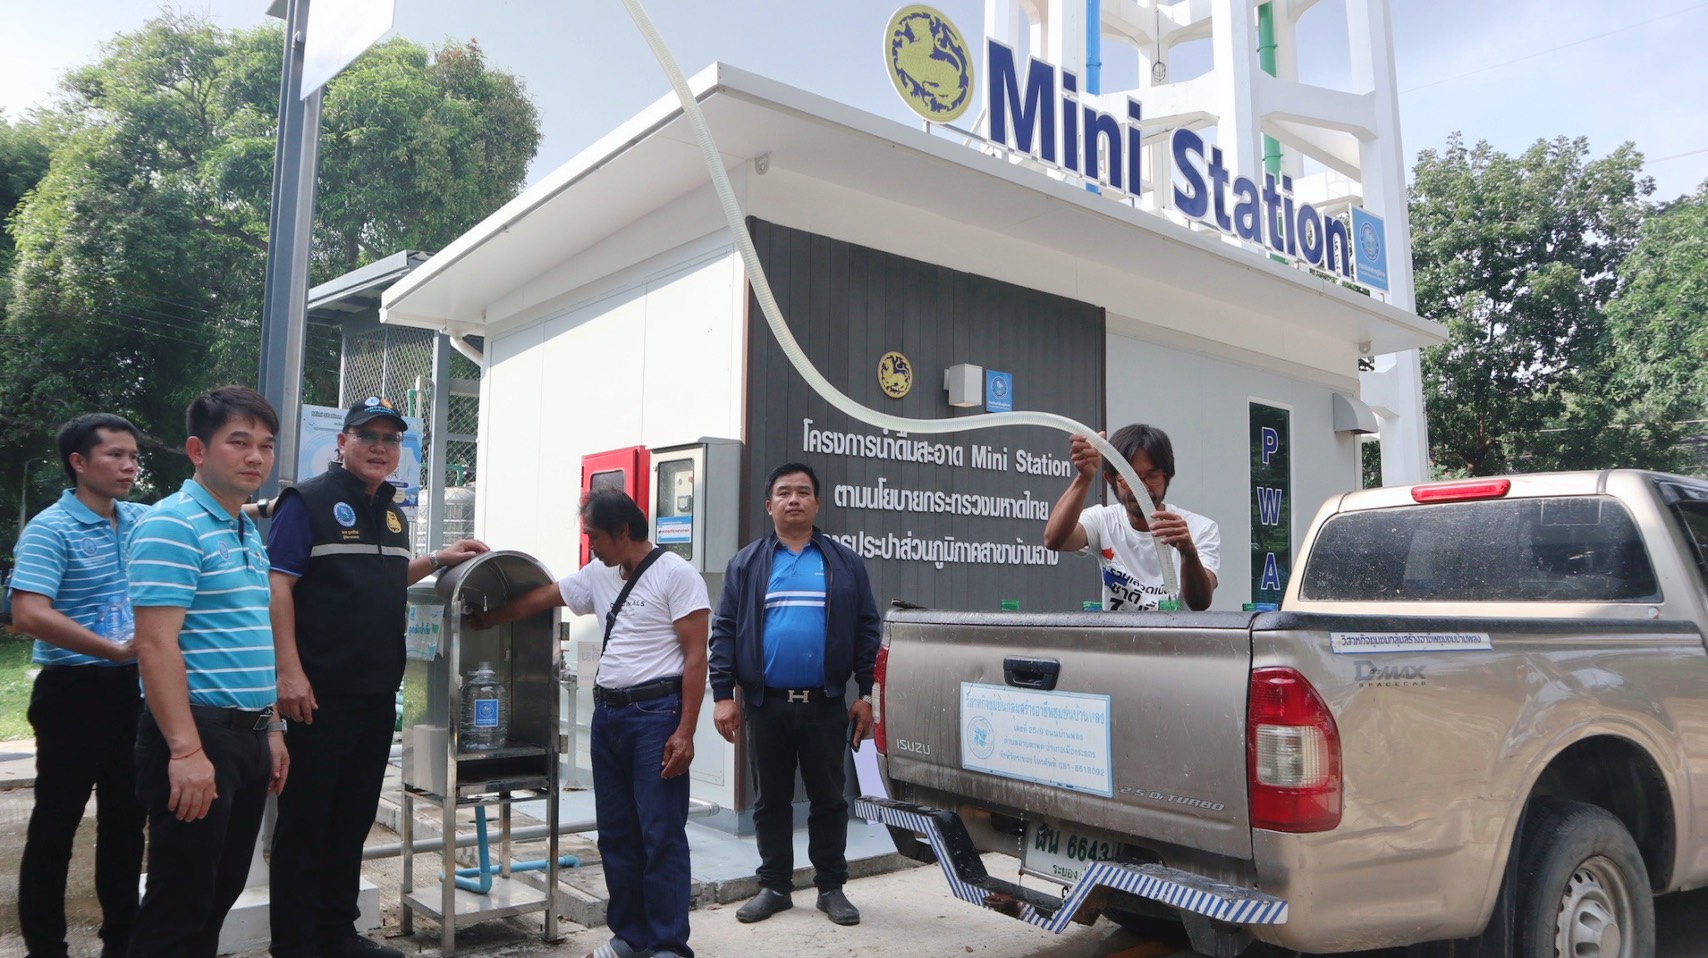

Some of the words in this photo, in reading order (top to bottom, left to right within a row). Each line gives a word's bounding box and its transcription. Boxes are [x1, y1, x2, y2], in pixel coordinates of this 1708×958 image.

[987, 37, 1142, 199] Mini
[1170, 127, 1351, 279] Station
[803, 418, 963, 467] โครงการนำดืมสะอาด
[972, 445, 1008, 471] Mini
[1016, 449, 1071, 477] Station
[834, 477, 1049, 520] ตามนโยบายกระทรวงมหาดไทย
[823, 530, 1059, 570] รประปาส่วนภูมิภาคสาขาบ้านฉาง
[896, 739, 931, 755] ISUZU
[1167, 794, 1225, 811] TURBO
